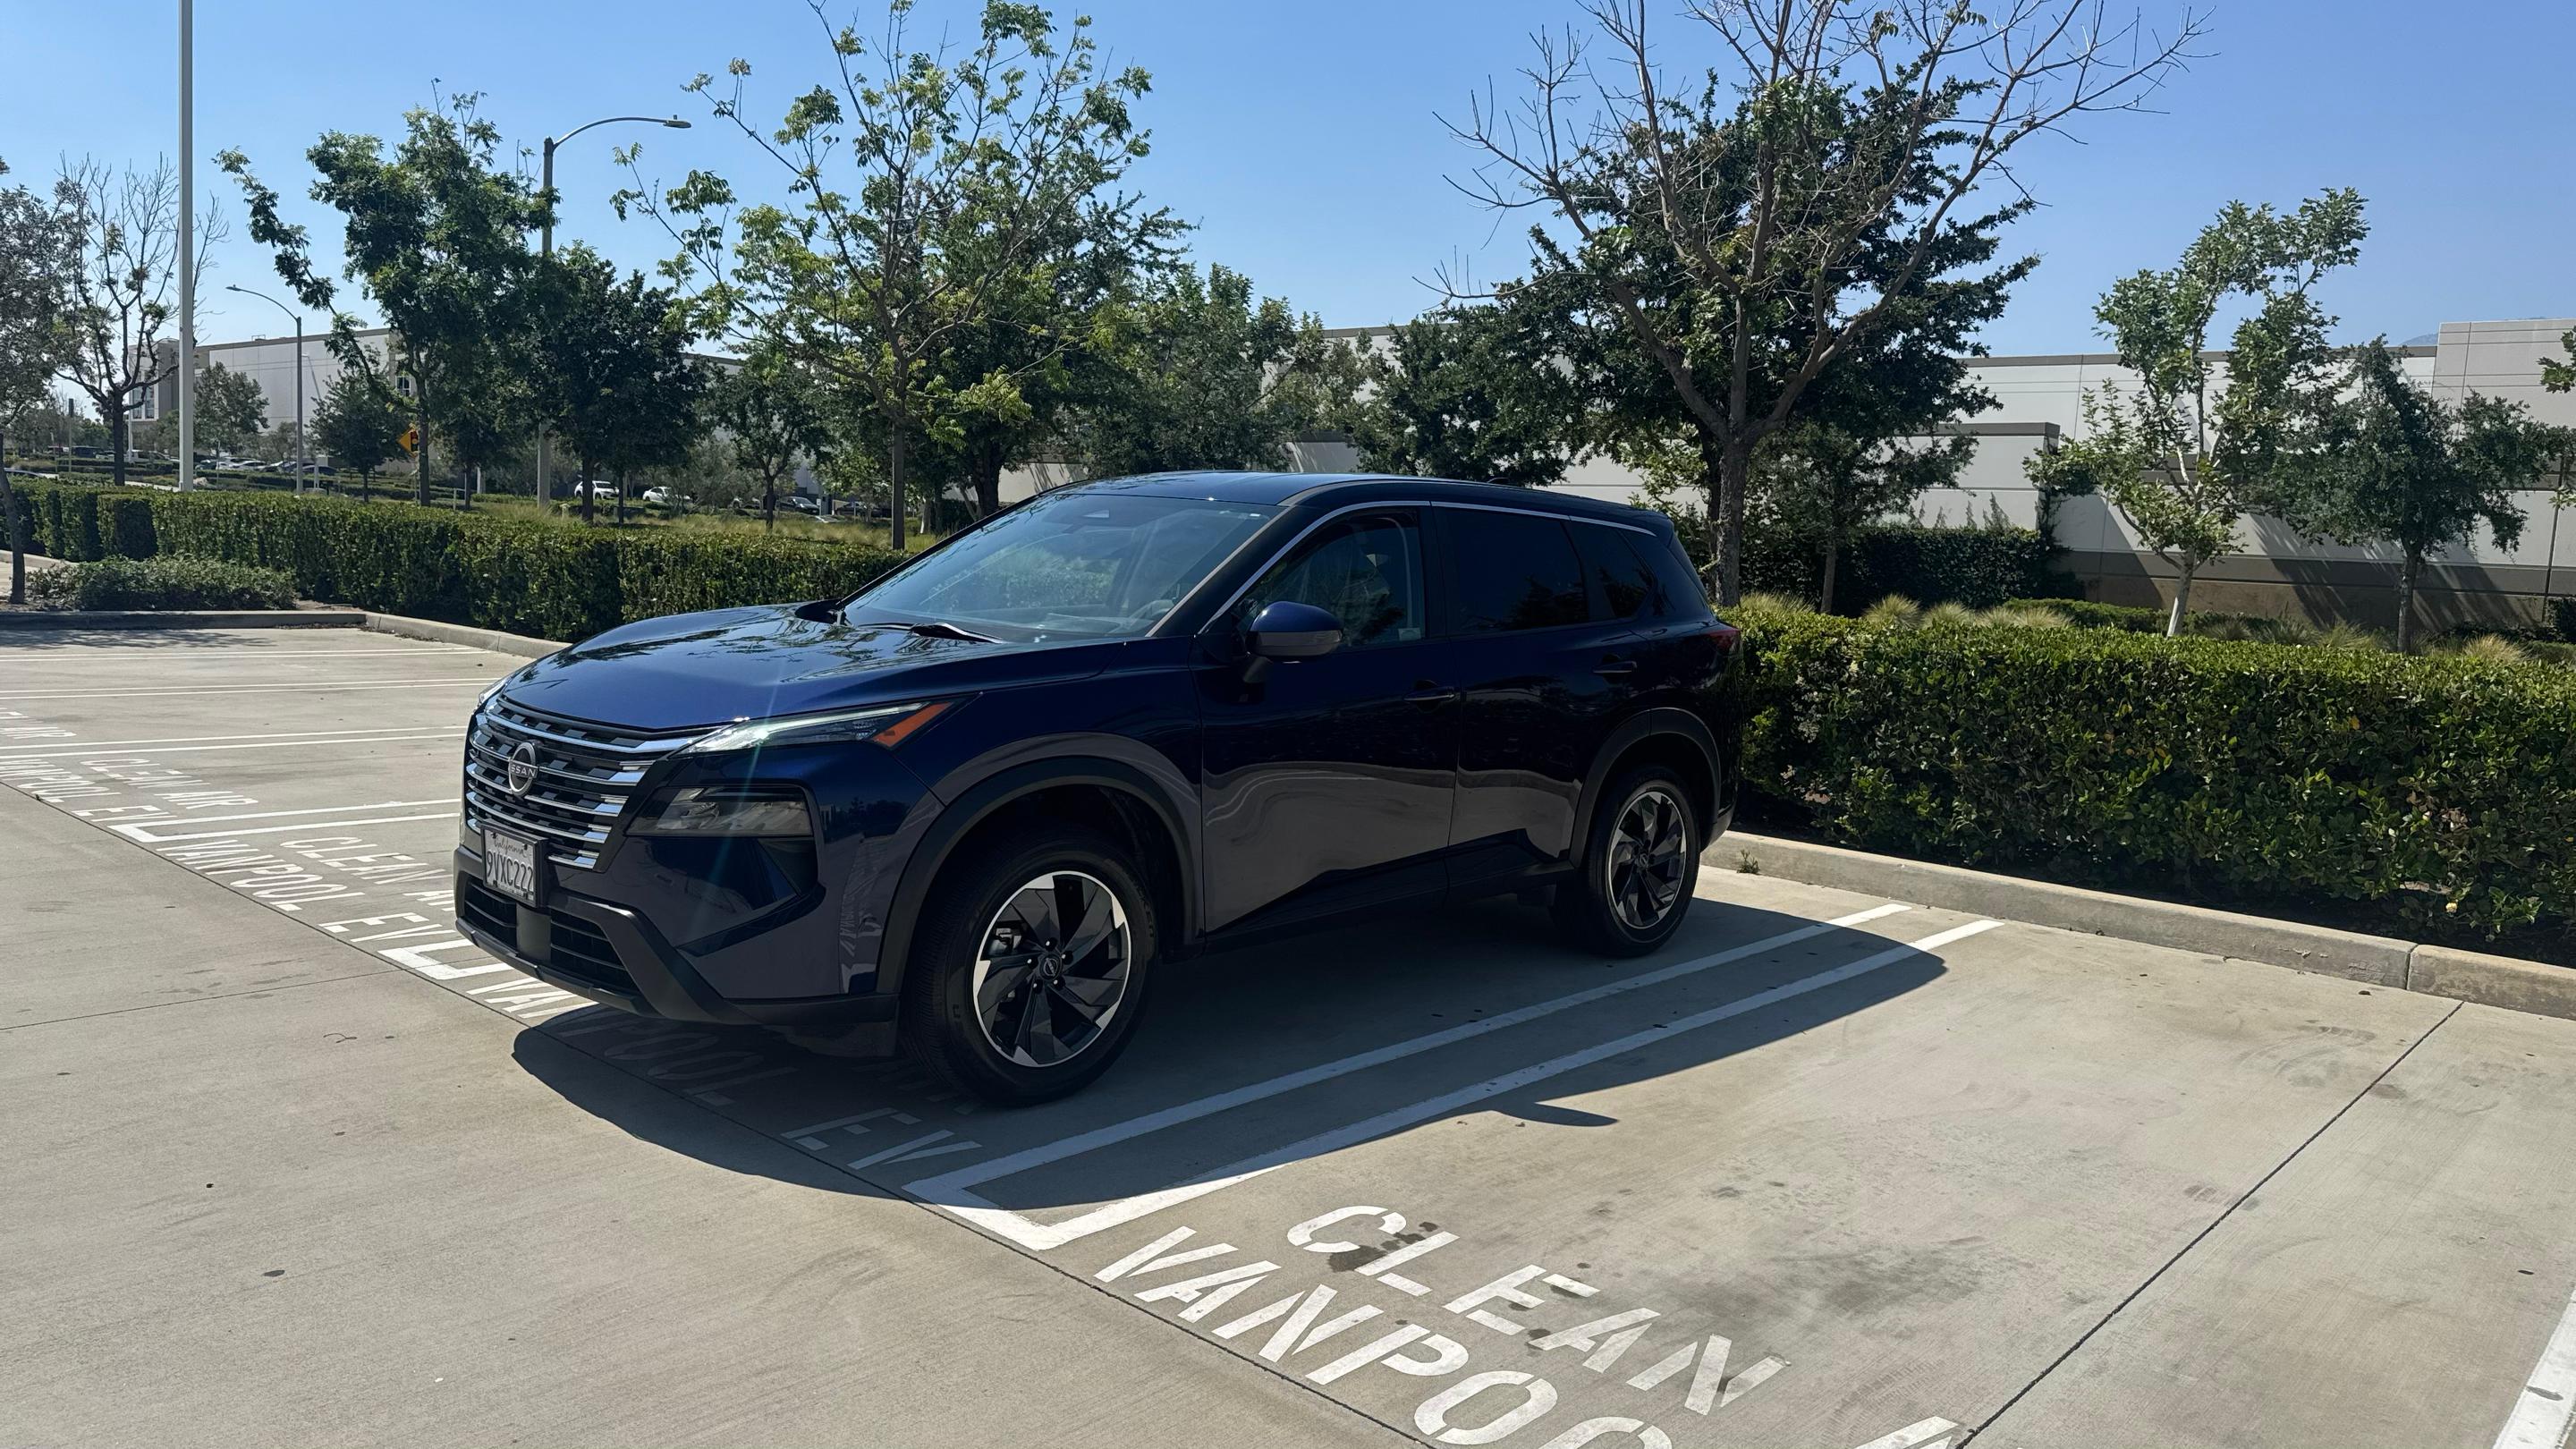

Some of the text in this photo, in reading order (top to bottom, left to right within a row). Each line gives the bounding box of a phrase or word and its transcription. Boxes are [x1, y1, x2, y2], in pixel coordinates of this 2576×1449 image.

[80, 758, 259, 809] CLEAN AIR
[71, 805, 178, 822] EV
[279, 837, 455, 886] CLEAN
[494, 835, 528, 859] California
[156, 840, 366, 911] VANPOOL
[487, 851, 535, 894] 9VXC222
[318, 912, 457, 943] EV
[782, 1106, 983, 1171] EV
[1286, 1204, 1787, 1416] CLEAN
